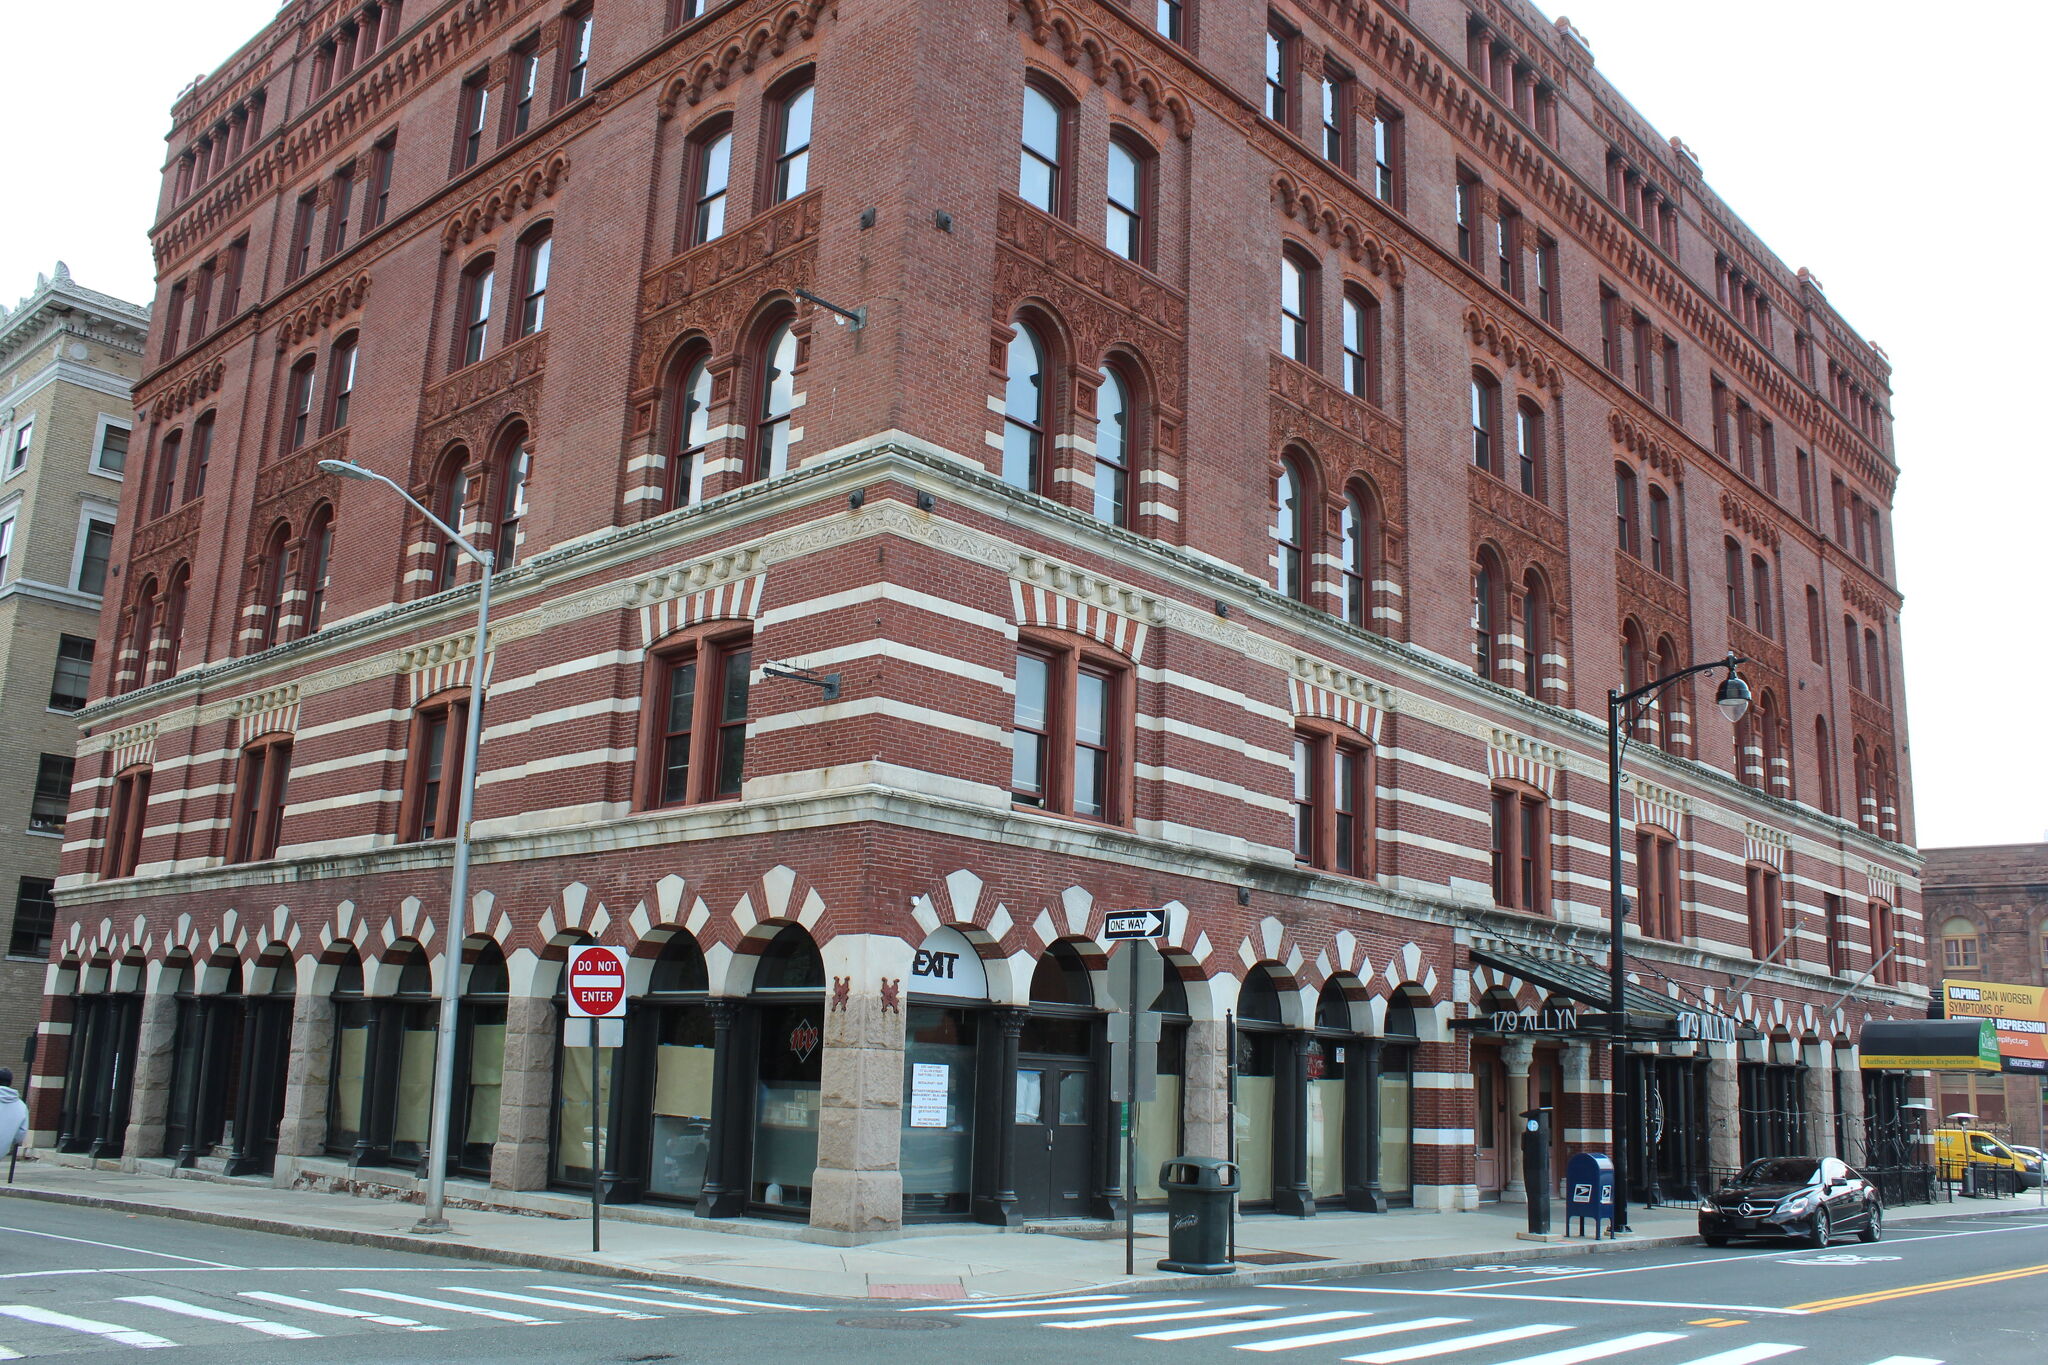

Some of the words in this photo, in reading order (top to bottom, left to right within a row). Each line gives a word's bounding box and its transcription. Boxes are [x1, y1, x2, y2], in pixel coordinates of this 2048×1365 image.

[1110, 919, 1125, 931] ONE
[1127, 918, 1146, 930] WAY
[578, 960, 592, 972] DO
[597, 960, 617, 972] NOT
[912, 949, 960, 979] EXIT
[581, 991, 613, 1002] ENTER
[1949, 987, 1980, 1001] VAPING
[1981, 990, 1998, 1001] CAN
[2000, 991, 2033, 1005] WORSEN
[1949, 1001, 1992, 1014] SYMPTOMS
[1994, 1005, 2004, 1015] OF
[1489, 1010, 1518, 1032] 179
[1523, 1008, 1577, 1031] ALLYN
[1676, 1011, 1699, 1039] 179
[1996, 1018, 2046, 1033] DEPRESSION
[1996, 1036, 2029, 1046] mplifyct.org
[1936, 1058, 1975, 1067] Experience
